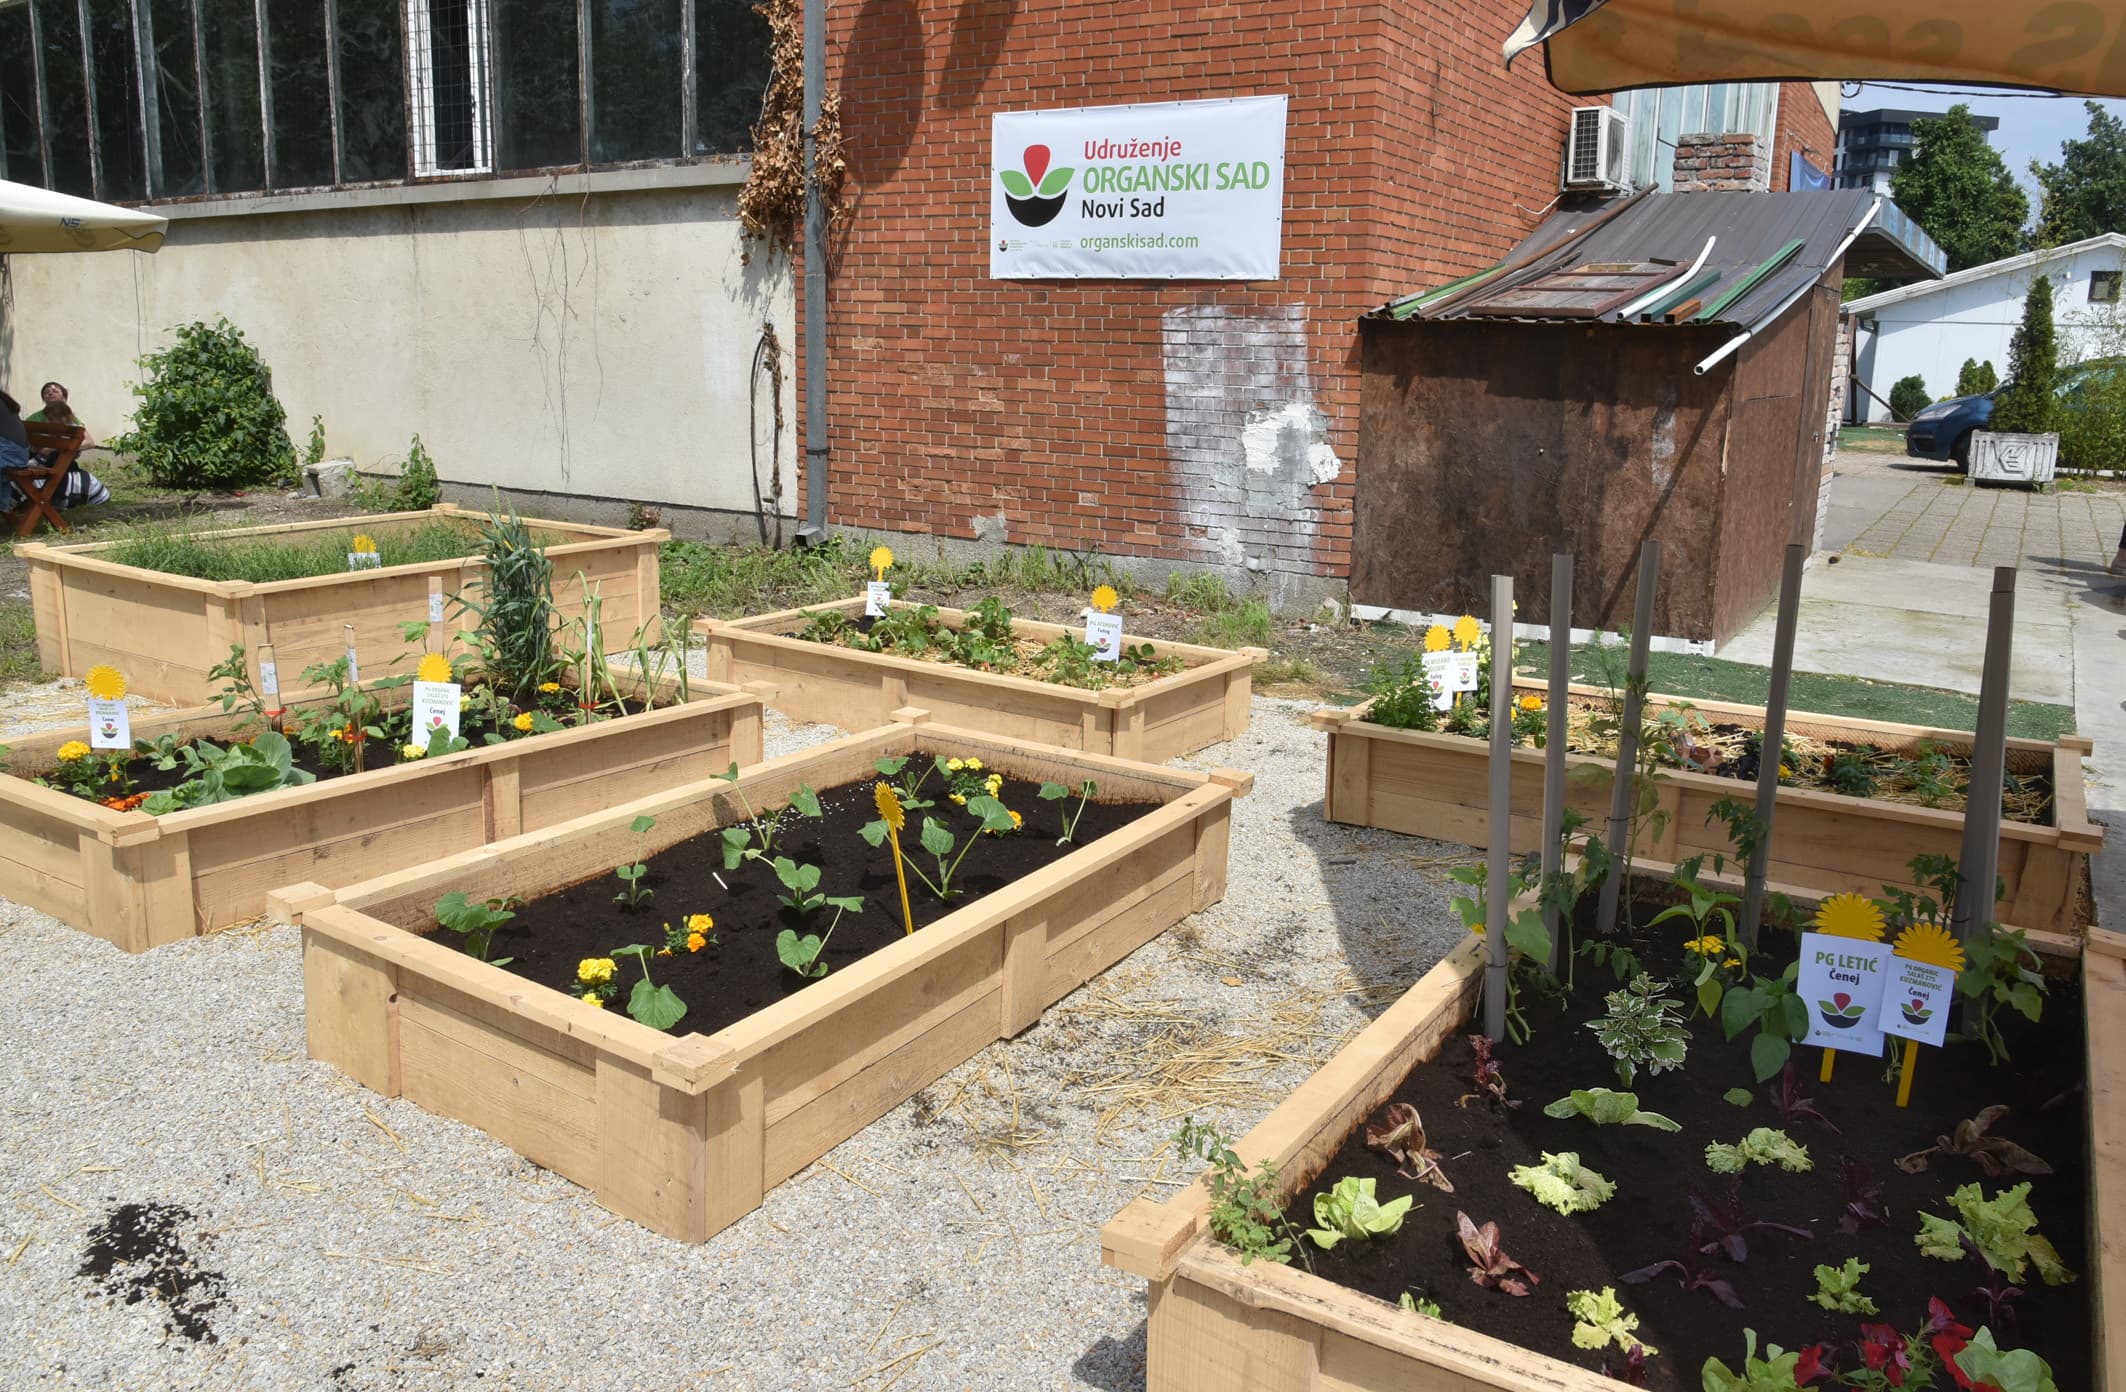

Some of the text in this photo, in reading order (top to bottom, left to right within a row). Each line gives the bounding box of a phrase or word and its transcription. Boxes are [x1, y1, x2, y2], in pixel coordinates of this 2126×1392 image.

[1084, 136, 1182, 162] Udruženje
[1083, 161, 1270, 194] ORGANSKI SAD
[1082, 196, 1165, 218] Novi Sad
[1080, 233, 1199, 252] organskisad.com
[1815, 951, 1879, 973] PG LETIĆ
[1829, 969, 1860, 986] Čenej
[1908, 986, 1929, 1000] Čenej
